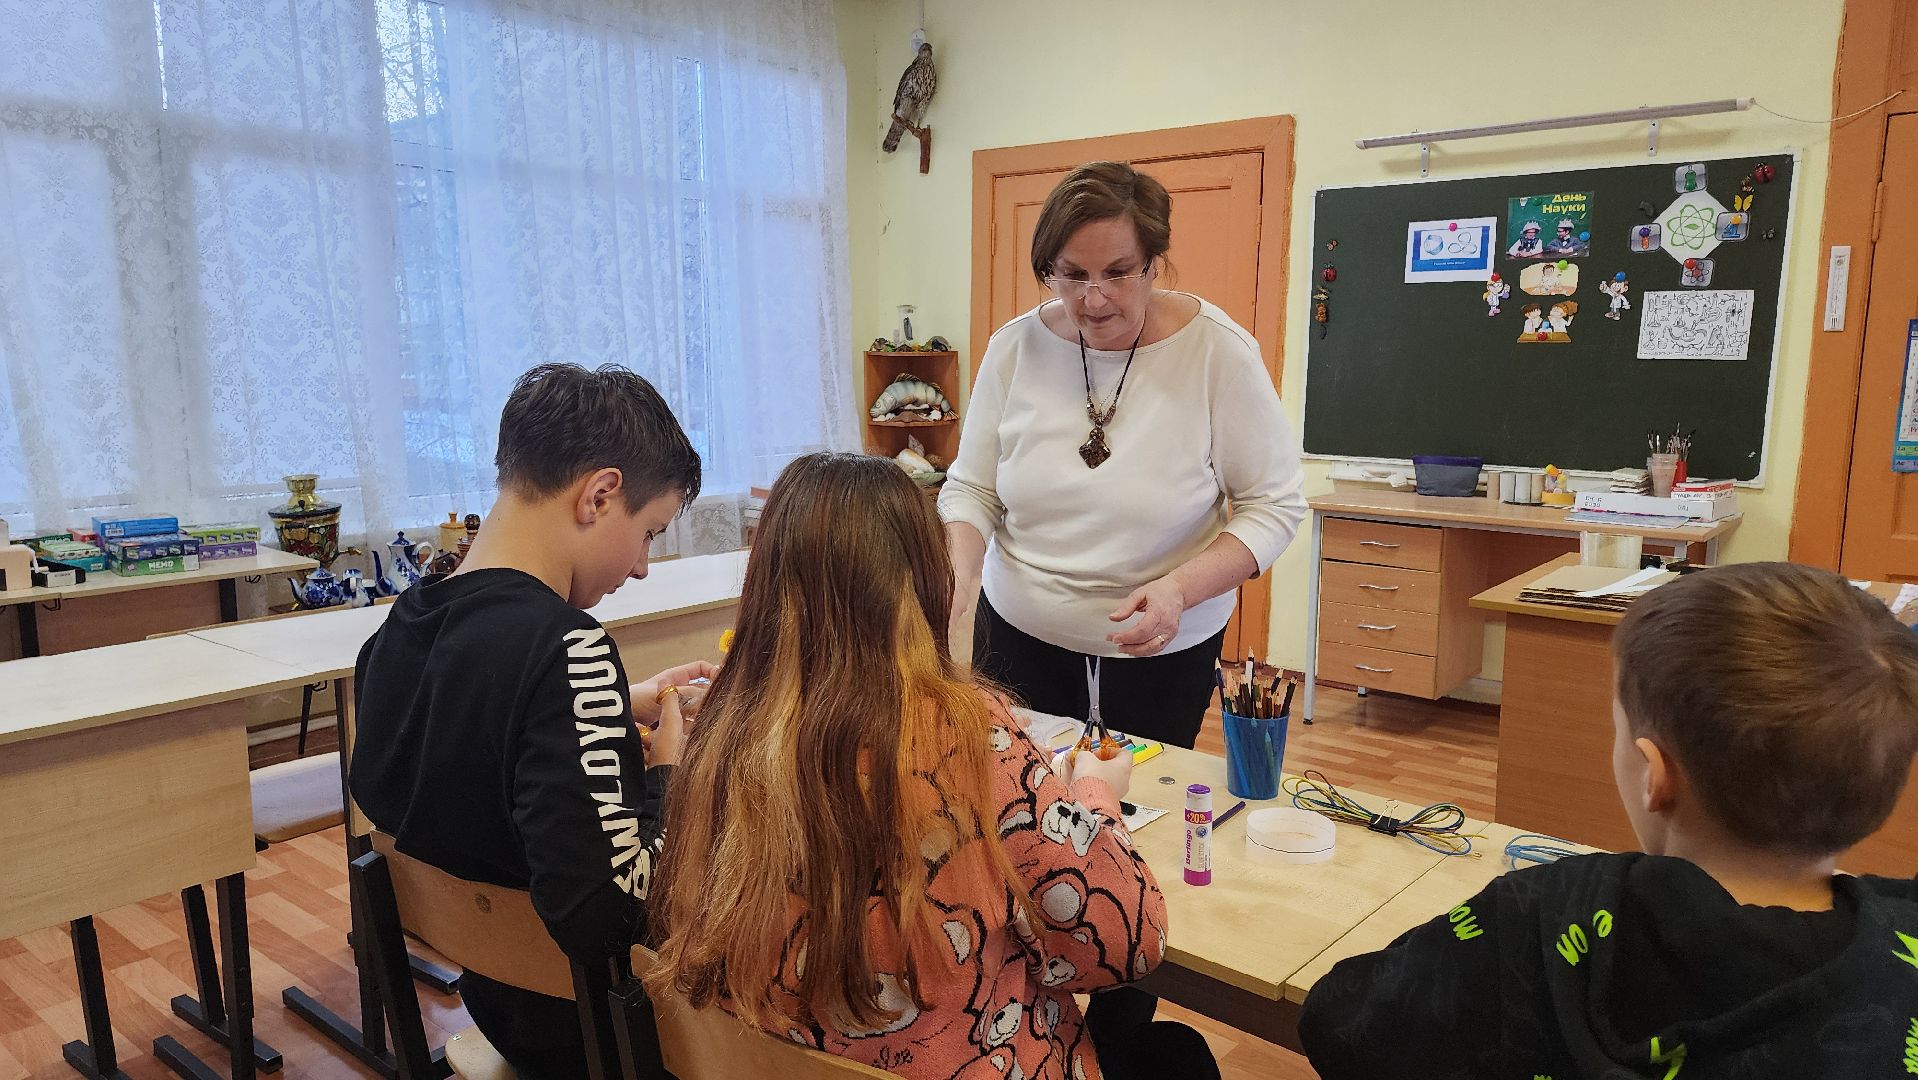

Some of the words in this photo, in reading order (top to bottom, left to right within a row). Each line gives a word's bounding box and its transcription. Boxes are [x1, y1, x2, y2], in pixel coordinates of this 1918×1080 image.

[1552, 193, 1586, 203] День
[1542, 203, 1586, 214] Науки
[1185, 829, 1193, 865] Berlingo
